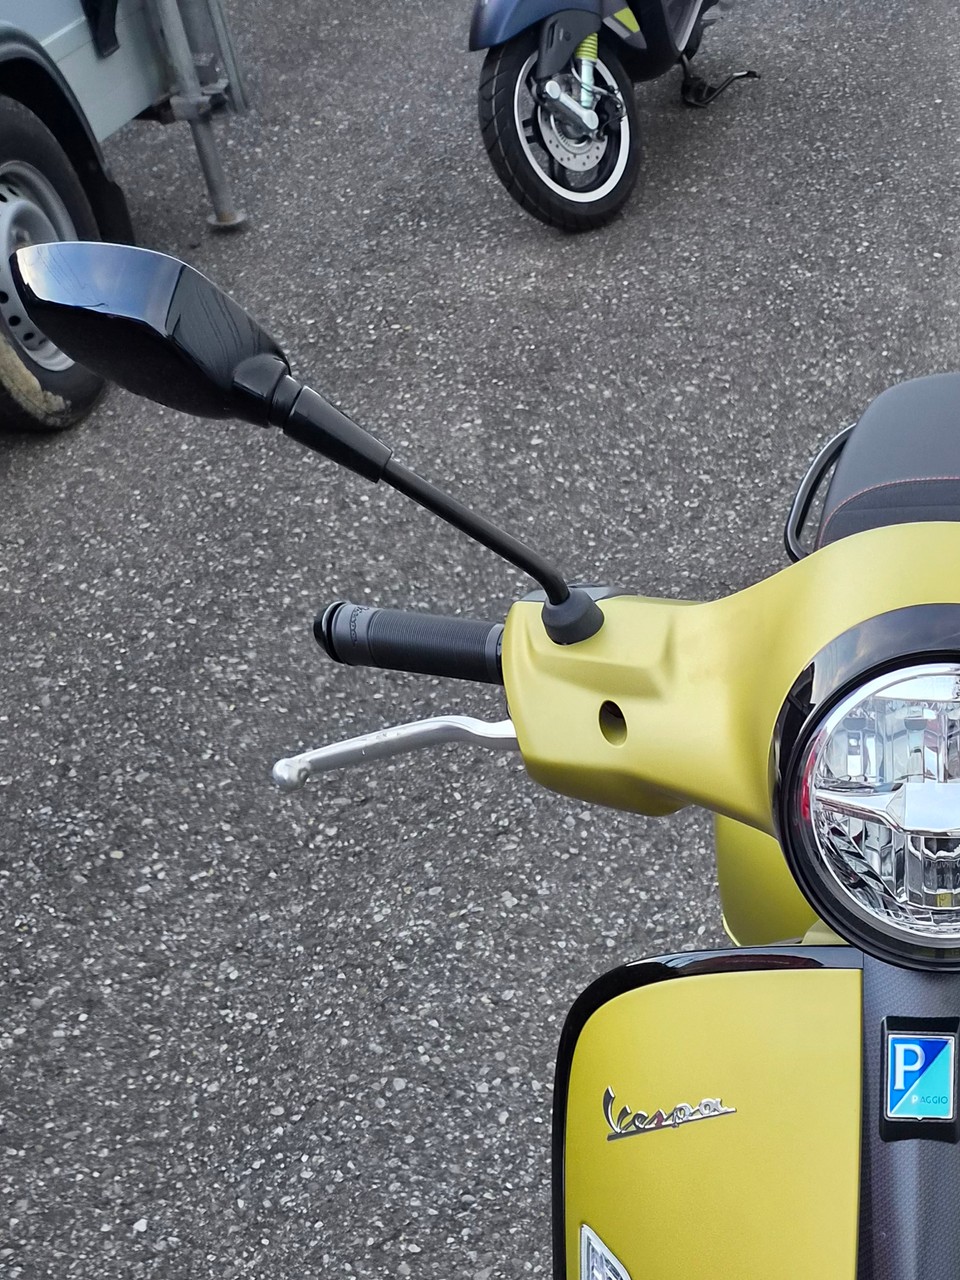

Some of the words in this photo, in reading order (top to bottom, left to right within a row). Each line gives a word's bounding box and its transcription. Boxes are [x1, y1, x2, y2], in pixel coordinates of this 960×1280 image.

[893, 1043, 925, 1090] P
[603, 1085, 737, 1141] Vespa
[911, 1094, 949, 1105] PAGGIO
